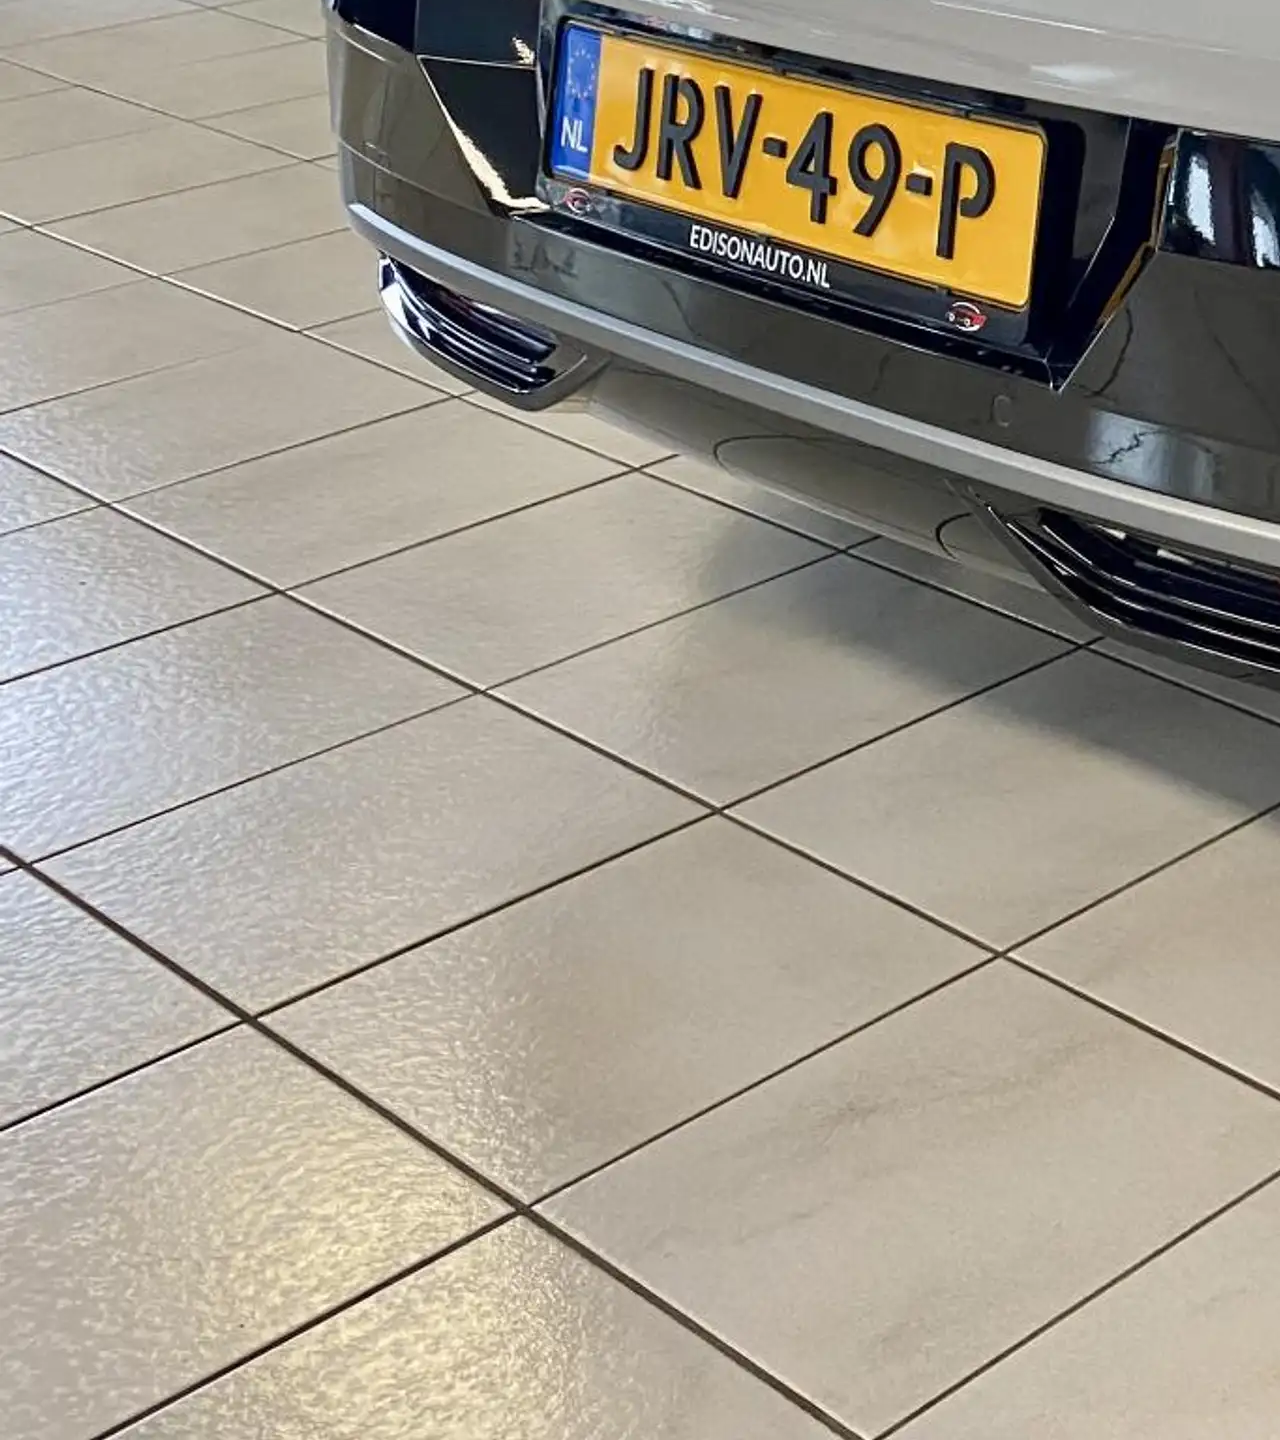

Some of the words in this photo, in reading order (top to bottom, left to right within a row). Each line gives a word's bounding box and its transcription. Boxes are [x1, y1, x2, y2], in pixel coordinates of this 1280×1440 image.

[560, 115, 589, 153] NL
[612, 66, 996, 260] JRV-49-P
[689, 223, 831, 289] EDISONAUTO.NL
